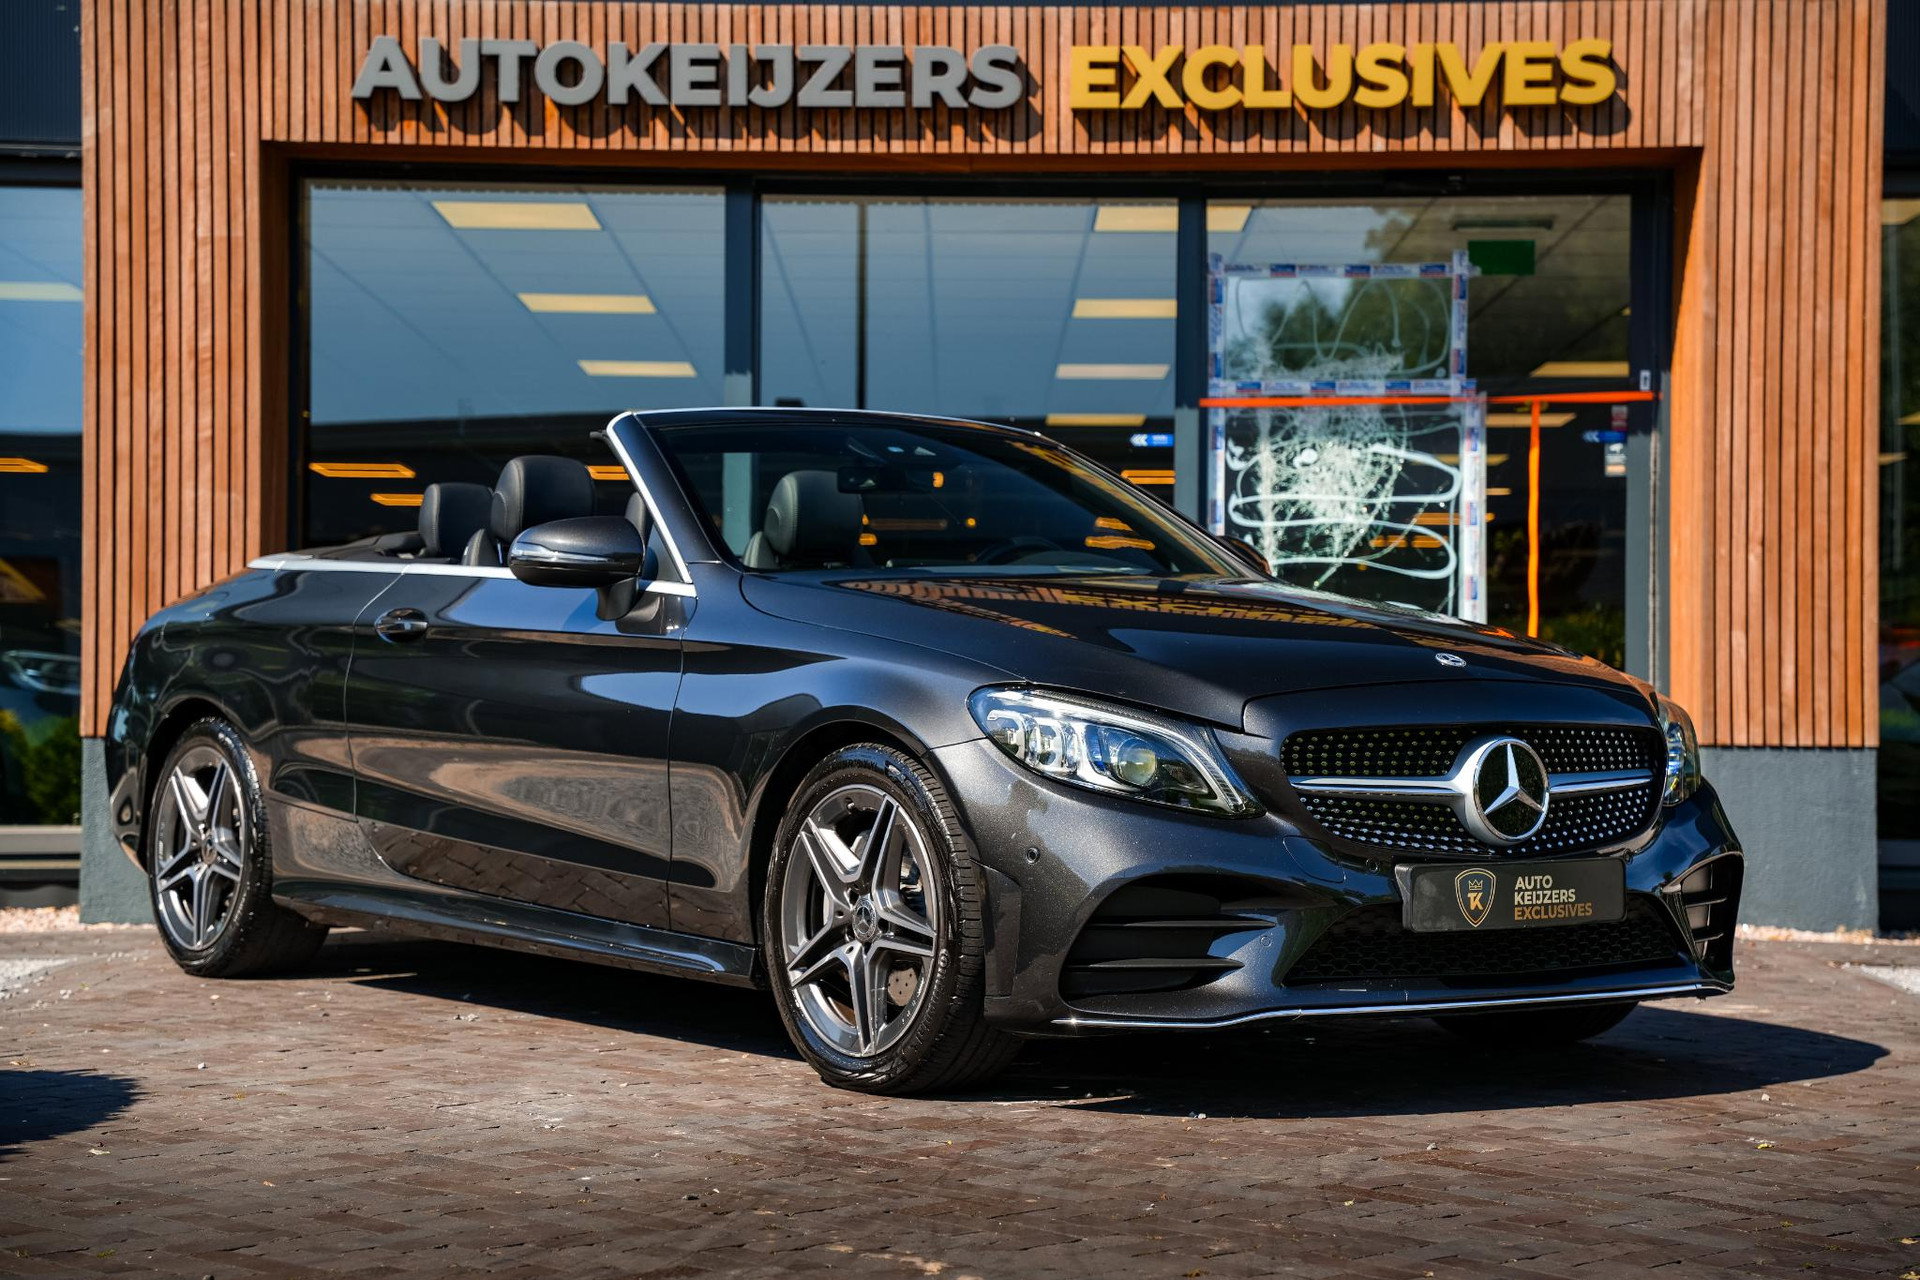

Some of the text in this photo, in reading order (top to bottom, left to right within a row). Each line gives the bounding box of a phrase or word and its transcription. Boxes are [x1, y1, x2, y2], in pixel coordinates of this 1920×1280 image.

[351, 35, 1617, 110] AUTOKEIJZERS EXCLUSIVES
[1515, 875, 1553, 890] AUTO
[1514, 889, 1576, 905] KEIJZERS
[1514, 903, 1593, 920] EXCLUSIVES
